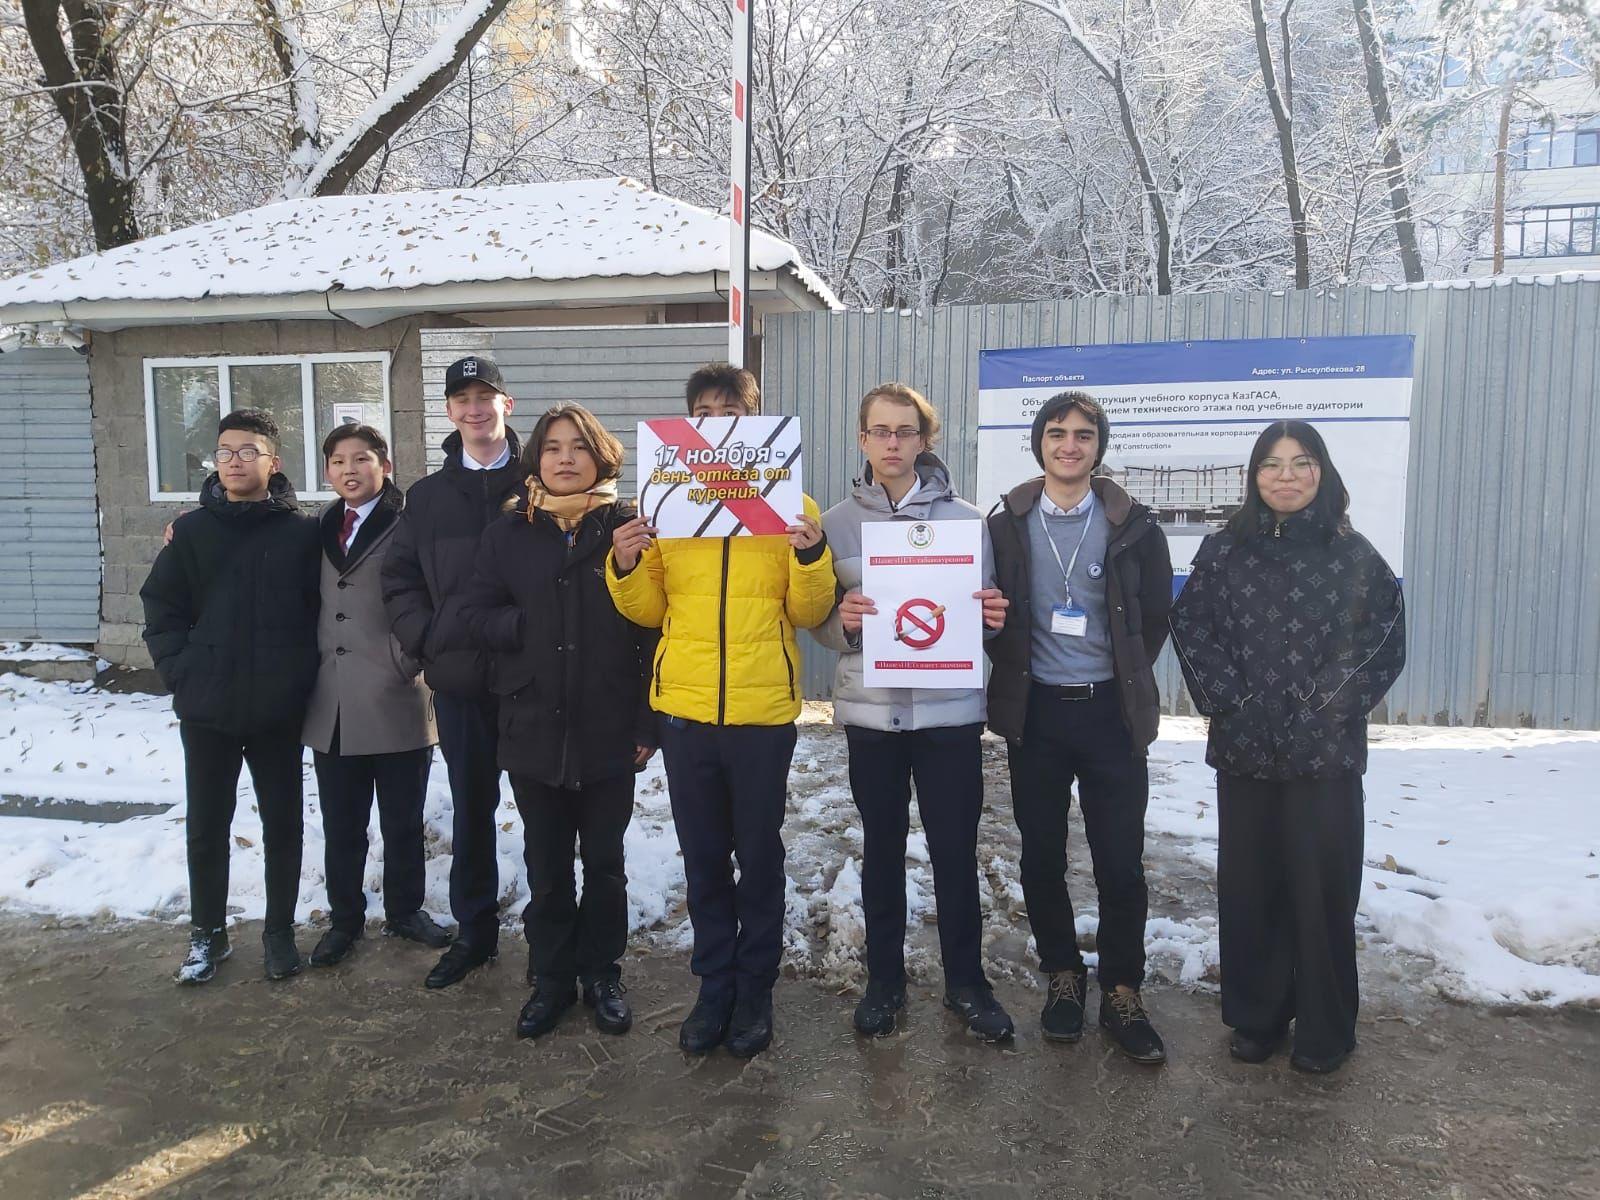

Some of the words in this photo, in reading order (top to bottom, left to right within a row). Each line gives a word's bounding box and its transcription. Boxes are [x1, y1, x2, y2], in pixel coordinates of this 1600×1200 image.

[1252, 367, 1280, 376] Адрес:
[1281, 368, 1293, 376] ул.
[1295, 366, 1354, 375] Рыскулбекова
[1022, 375, 1053, 385] Паспорт
[1055, 374, 1085, 382] объекта
[1139, 394, 1186, 404] учебного
[1188, 393, 1230, 403] корпуса
[1232, 390, 1281, 400] КазГАСА,
[1133, 405, 1199, 414] технического
[1202, 404, 1233, 412] этажа
[1235, 403, 1255, 412] под
[1257, 401, 1304, 413] учебные
[1306, 401, 1364, 411] аудитории
[1142, 430, 1209, 438] образовательная
[655, 443, 680, 466] 17
[685, 441, 771, 468] ноября
[650, 468, 692, 484] день
[696, 468, 760, 482] отказа
[763, 467, 791, 481] от
[687, 486, 759, 504] курения
